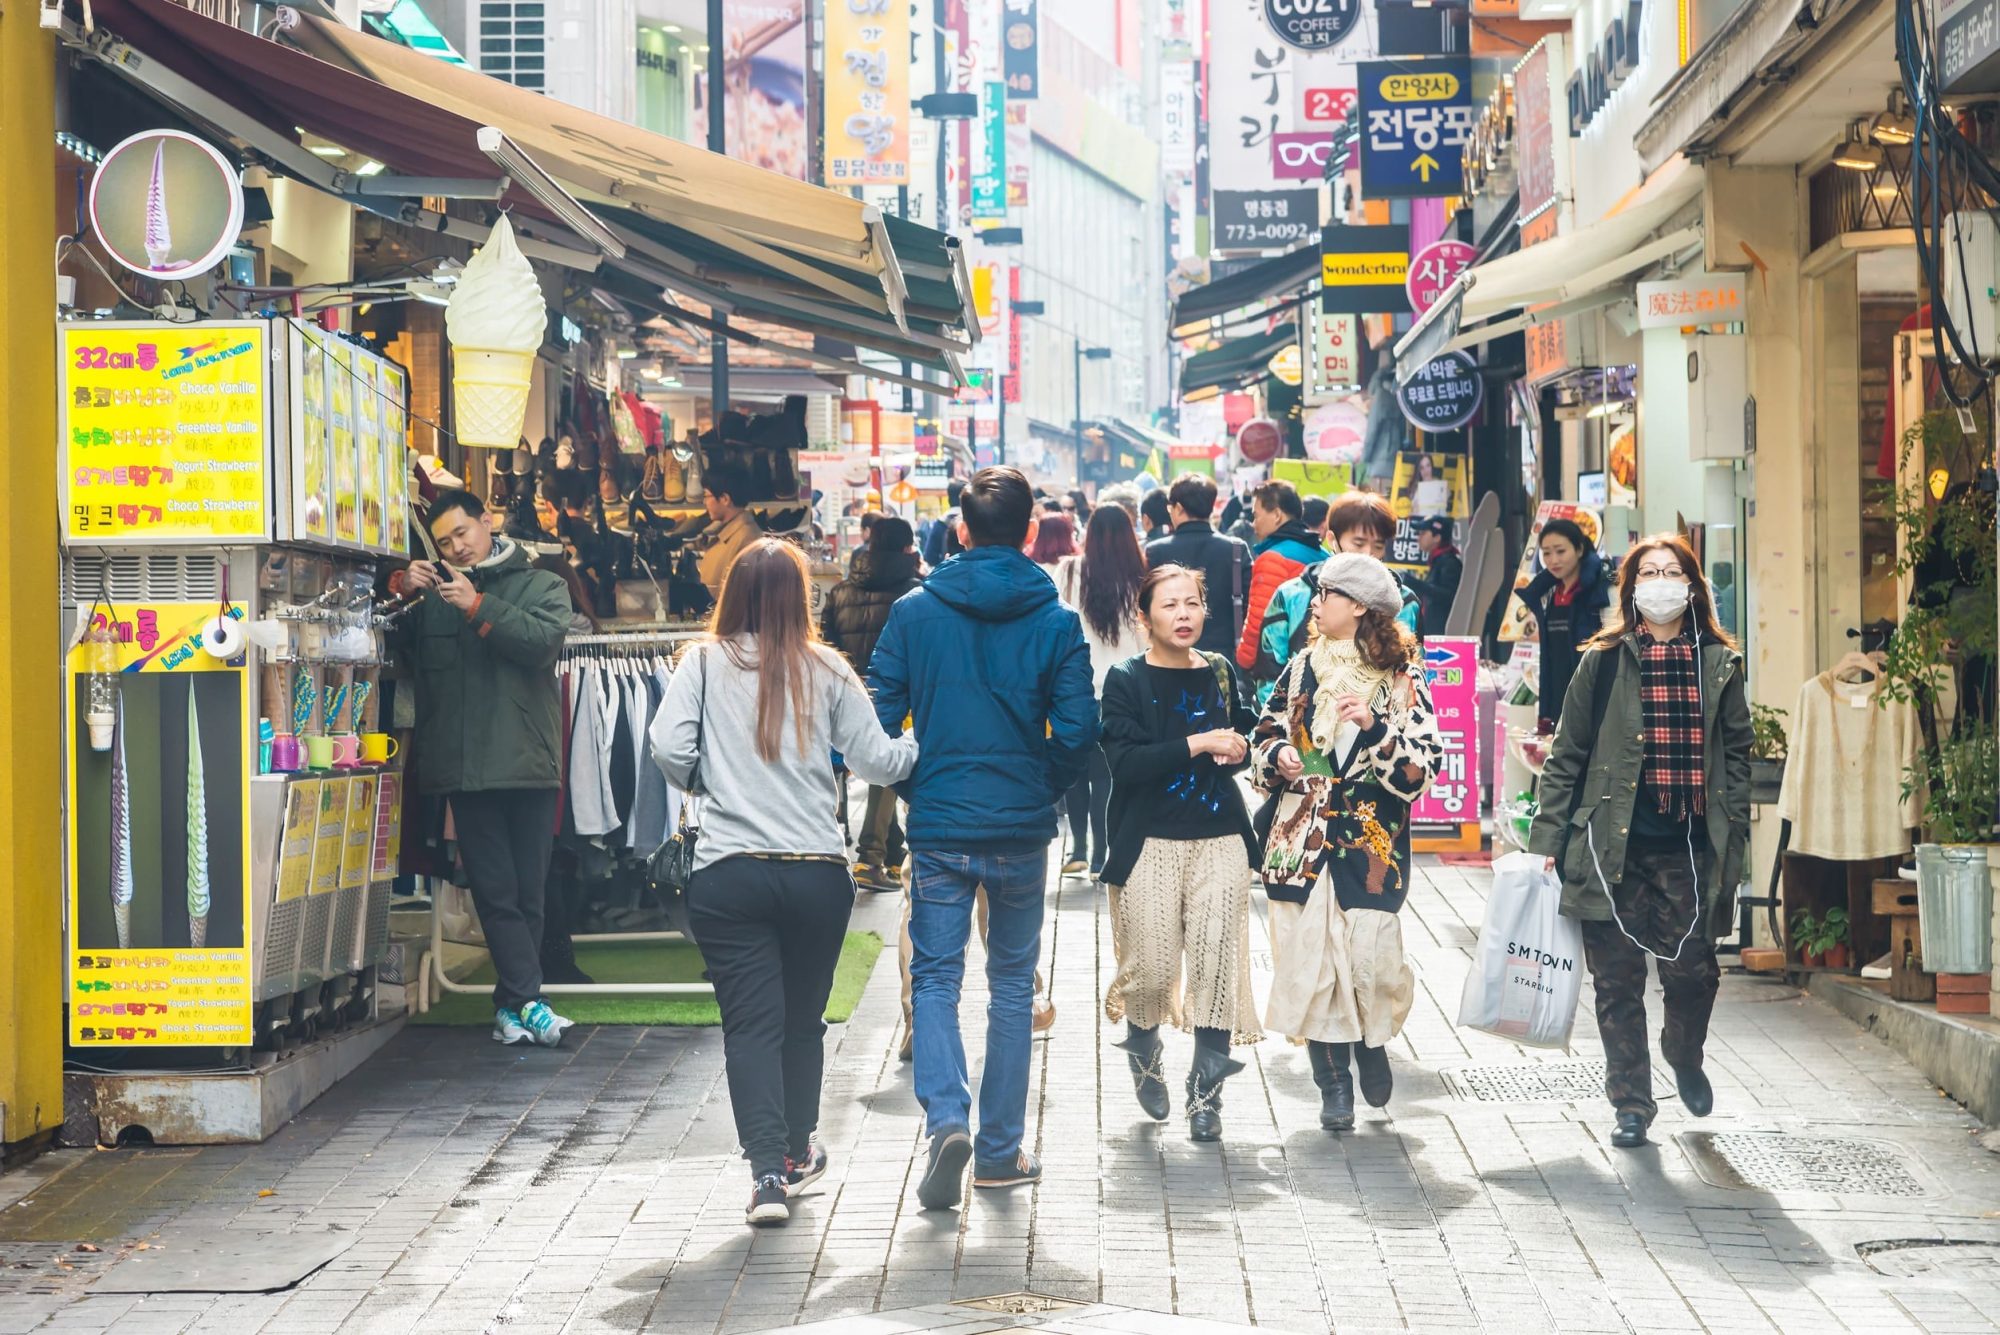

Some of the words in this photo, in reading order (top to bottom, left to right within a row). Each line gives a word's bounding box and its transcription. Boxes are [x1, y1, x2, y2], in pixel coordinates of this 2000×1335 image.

[1288, 17, 1341, 32] COFFEE
[1300, 33, 1330, 44] 코지
[1945, 21, 1965, 77] 명동점
[1390, 77, 1451, 97] 한양사
[1368, 106, 1473, 151] 전당포
[1244, 200, 1288, 218] 명동점
[1225, 223, 1308, 241] 773-0092
[1324, 263, 1407, 276] wonderbra
[1648, 288, 1742, 316] 魔法森林
[1325, 320, 1349, 382] 냉면
[1418, 359, 1457, 381] 케익을
[180, 382, 215, 394] Choco
[219, 381, 256, 393] Vanilla
[1408, 386, 1437, 404] 무료로
[1438, 380, 1473, 399] 드립니다
[1426, 404, 1459, 418] COZY
[177, 422, 222, 433] Greentea
[226, 422, 257, 433] Vanilla
[173, 460, 203, 473] Yogurt
[207, 459, 259, 471] Strawberry
[167, 499, 199, 511] Choco
[203, 499, 258, 512] Strawberry
[161, 643, 194, 670] Long
[1425, 668, 1461, 684] PEN
[174, 953, 205, 962] Choco
[210, 953, 243, 962] Vanilla
[171, 977, 211, 986] Greentea
[216, 977, 244, 986] Vanilla
[169, 1000, 195, 1010] Yogurt
[199, 1000, 245, 1010] Strawberry
[161, 1024, 190, 1034] Choco
[194, 1024, 244, 1034] Strawberry
